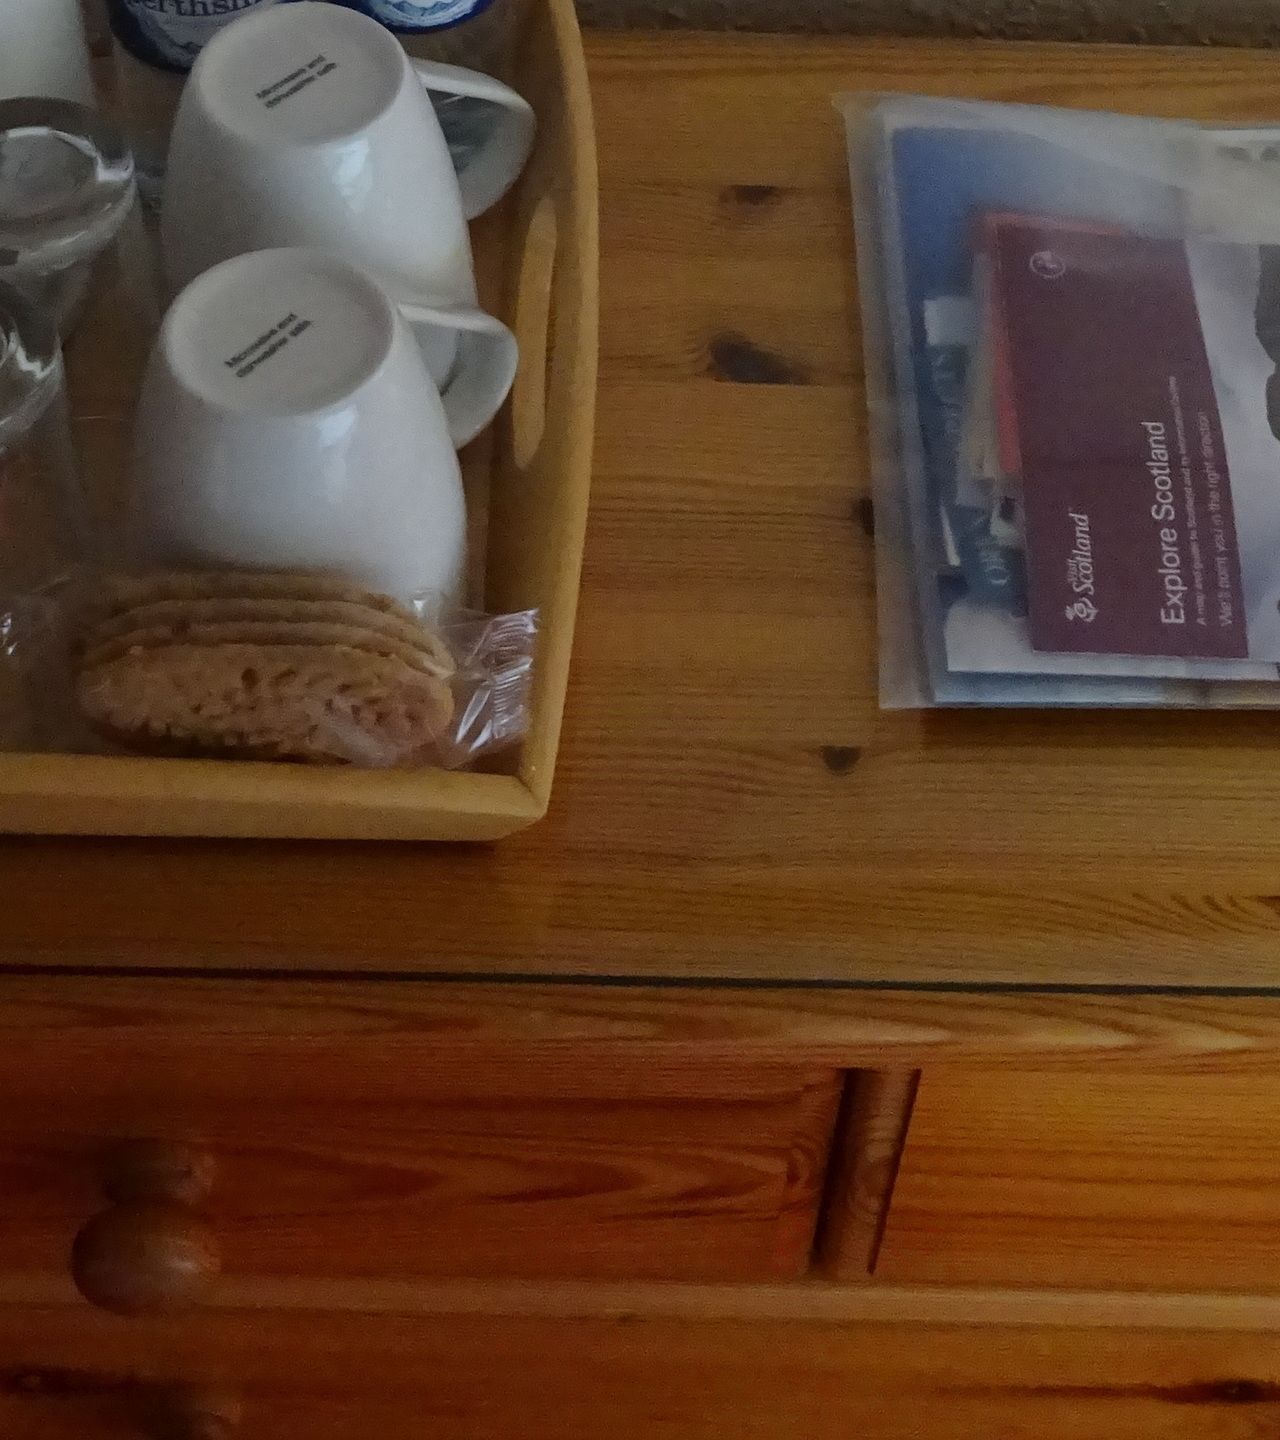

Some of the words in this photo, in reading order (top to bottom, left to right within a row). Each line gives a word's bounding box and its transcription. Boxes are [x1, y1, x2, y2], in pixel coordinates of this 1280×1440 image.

[1140, 421, 1175, 521] Scotland
[1203, 461, 1222, 489] right
[1208, 490, 1222, 512] the
[1068, 512, 1095, 596] Scotland
[1212, 529, 1228, 552] you
[1158, 527, 1188, 624] Explore
